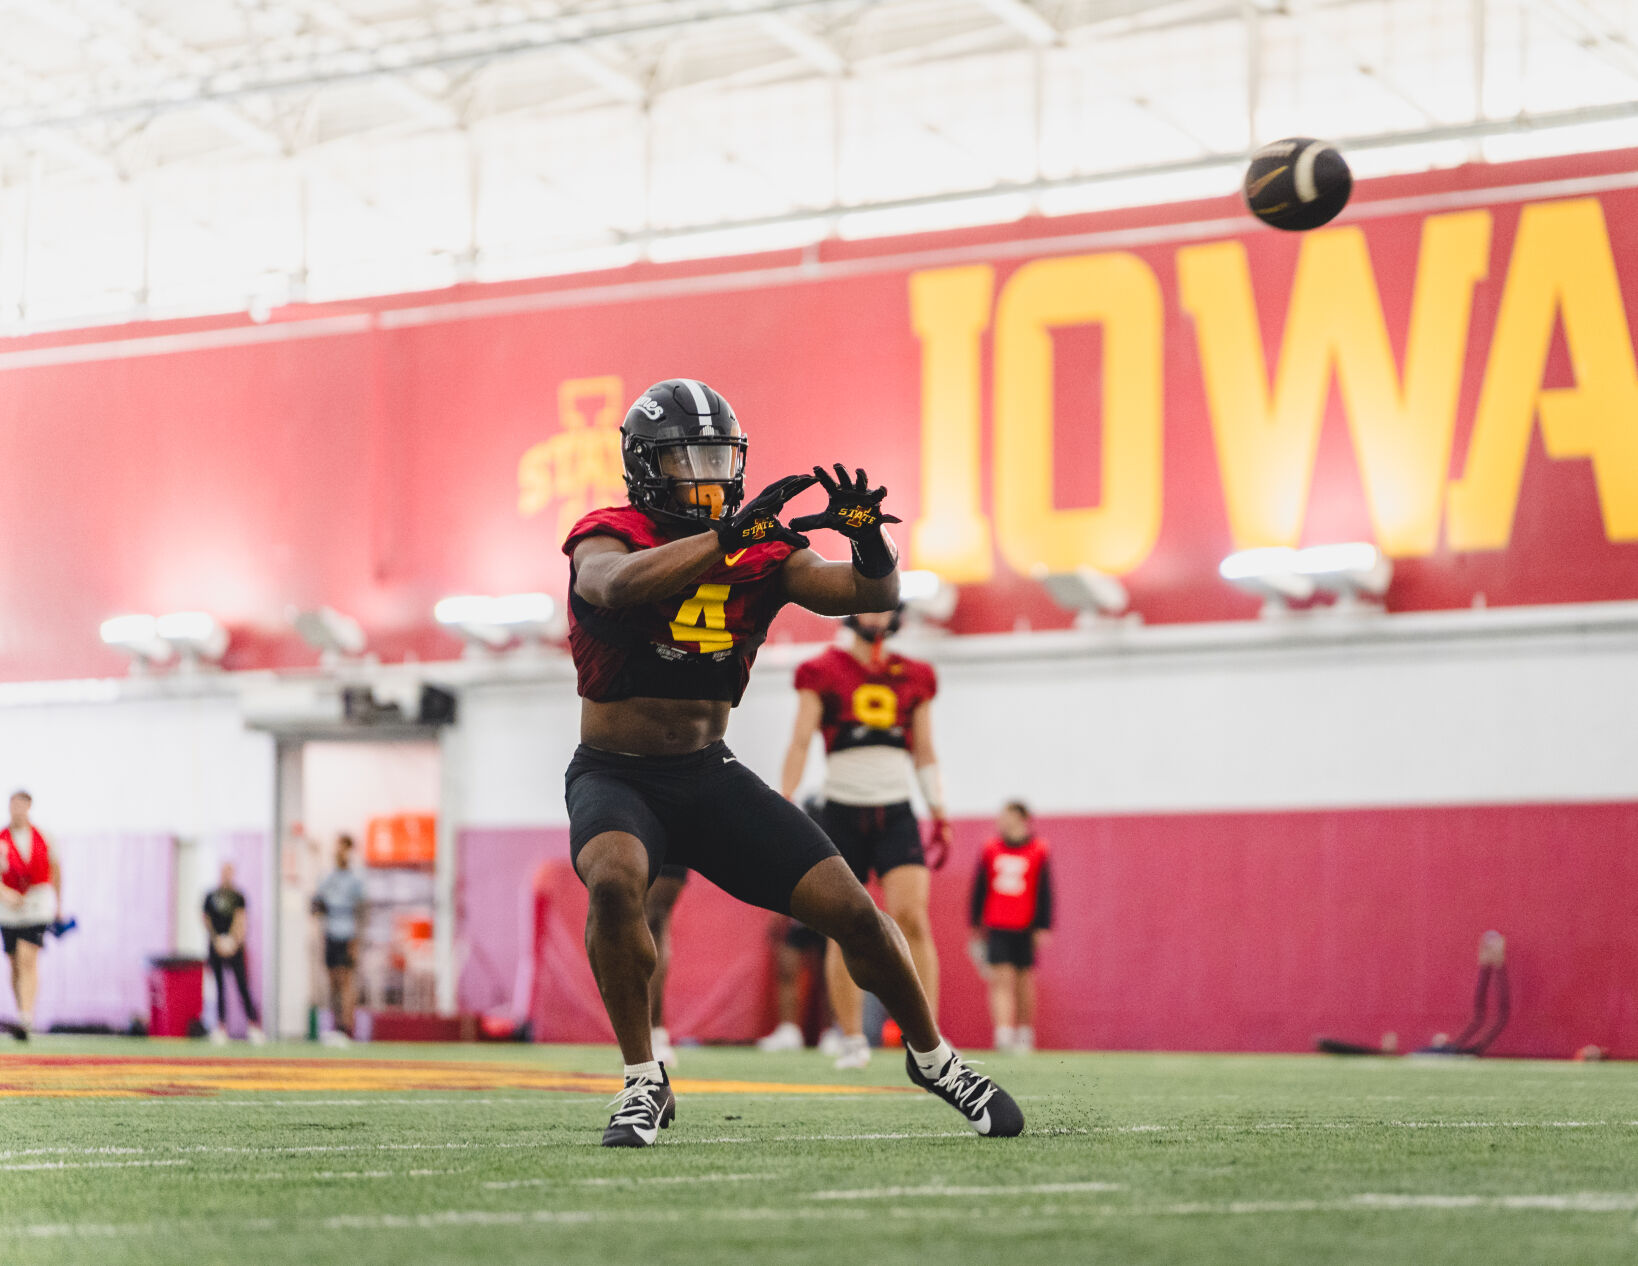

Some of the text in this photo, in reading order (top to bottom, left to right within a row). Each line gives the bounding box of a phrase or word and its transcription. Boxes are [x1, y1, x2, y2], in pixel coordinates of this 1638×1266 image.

[909, 198, 1638, 583] IOWA
[742, 519, 775, 538] STATE
[838, 507, 877, 526] STATE
[669, 583, 734, 654] 4
